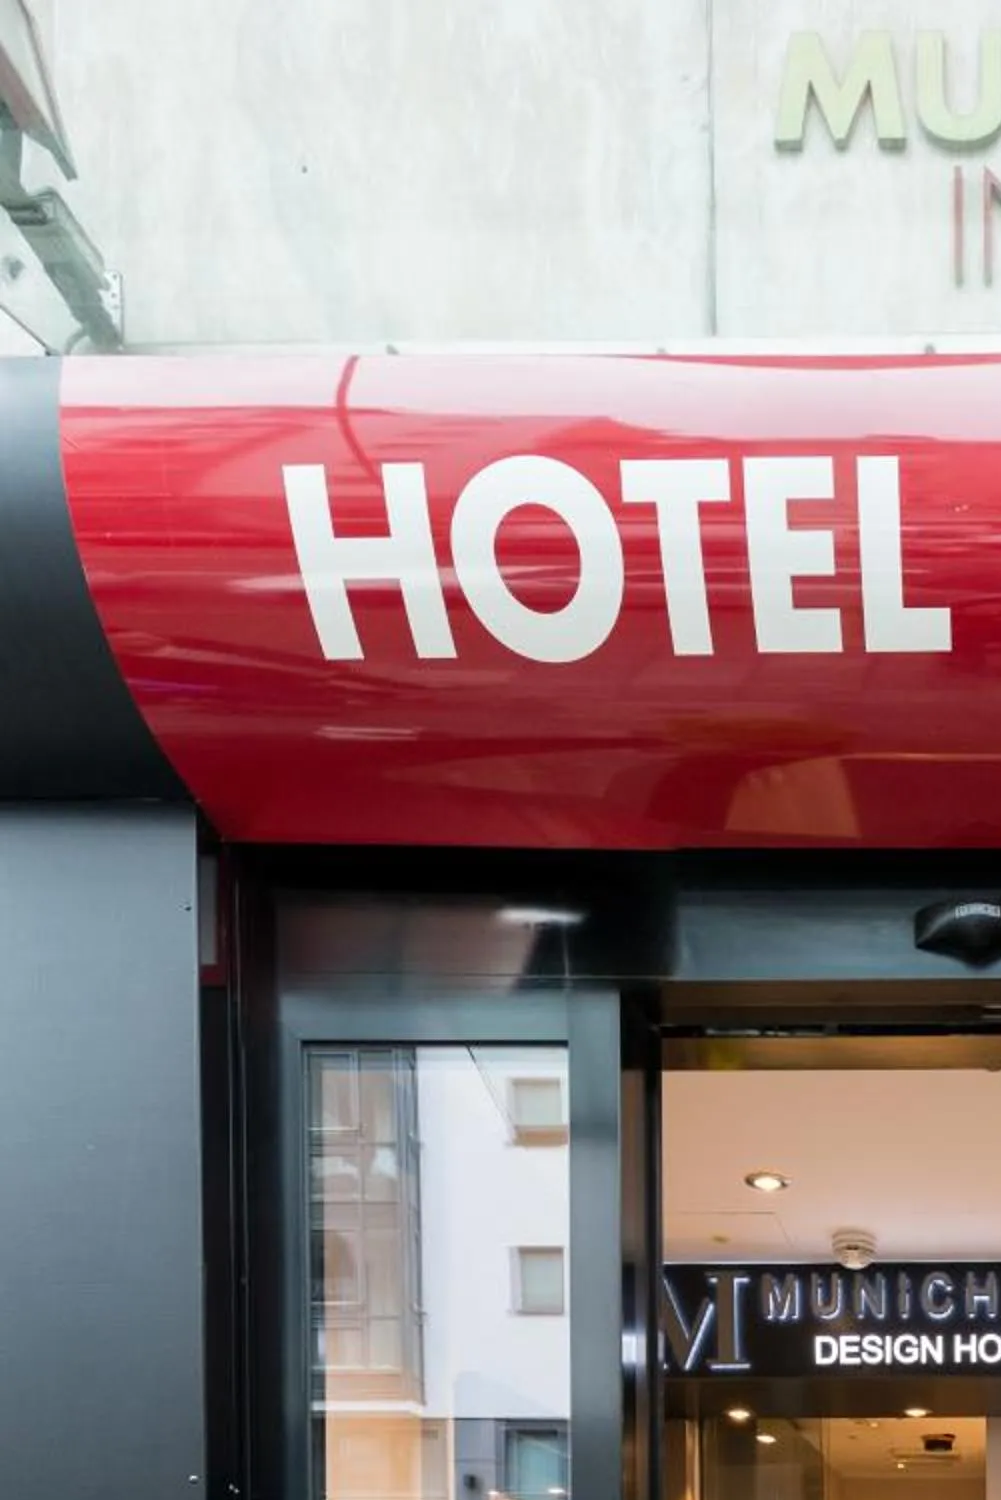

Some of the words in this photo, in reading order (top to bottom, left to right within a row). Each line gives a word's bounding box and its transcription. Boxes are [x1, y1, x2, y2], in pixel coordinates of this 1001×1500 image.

[282, 454, 953, 663] HOTEL
[760, 1271, 999, 1321] MUNICH
[813, 1334, 944, 1366] DESIGN
